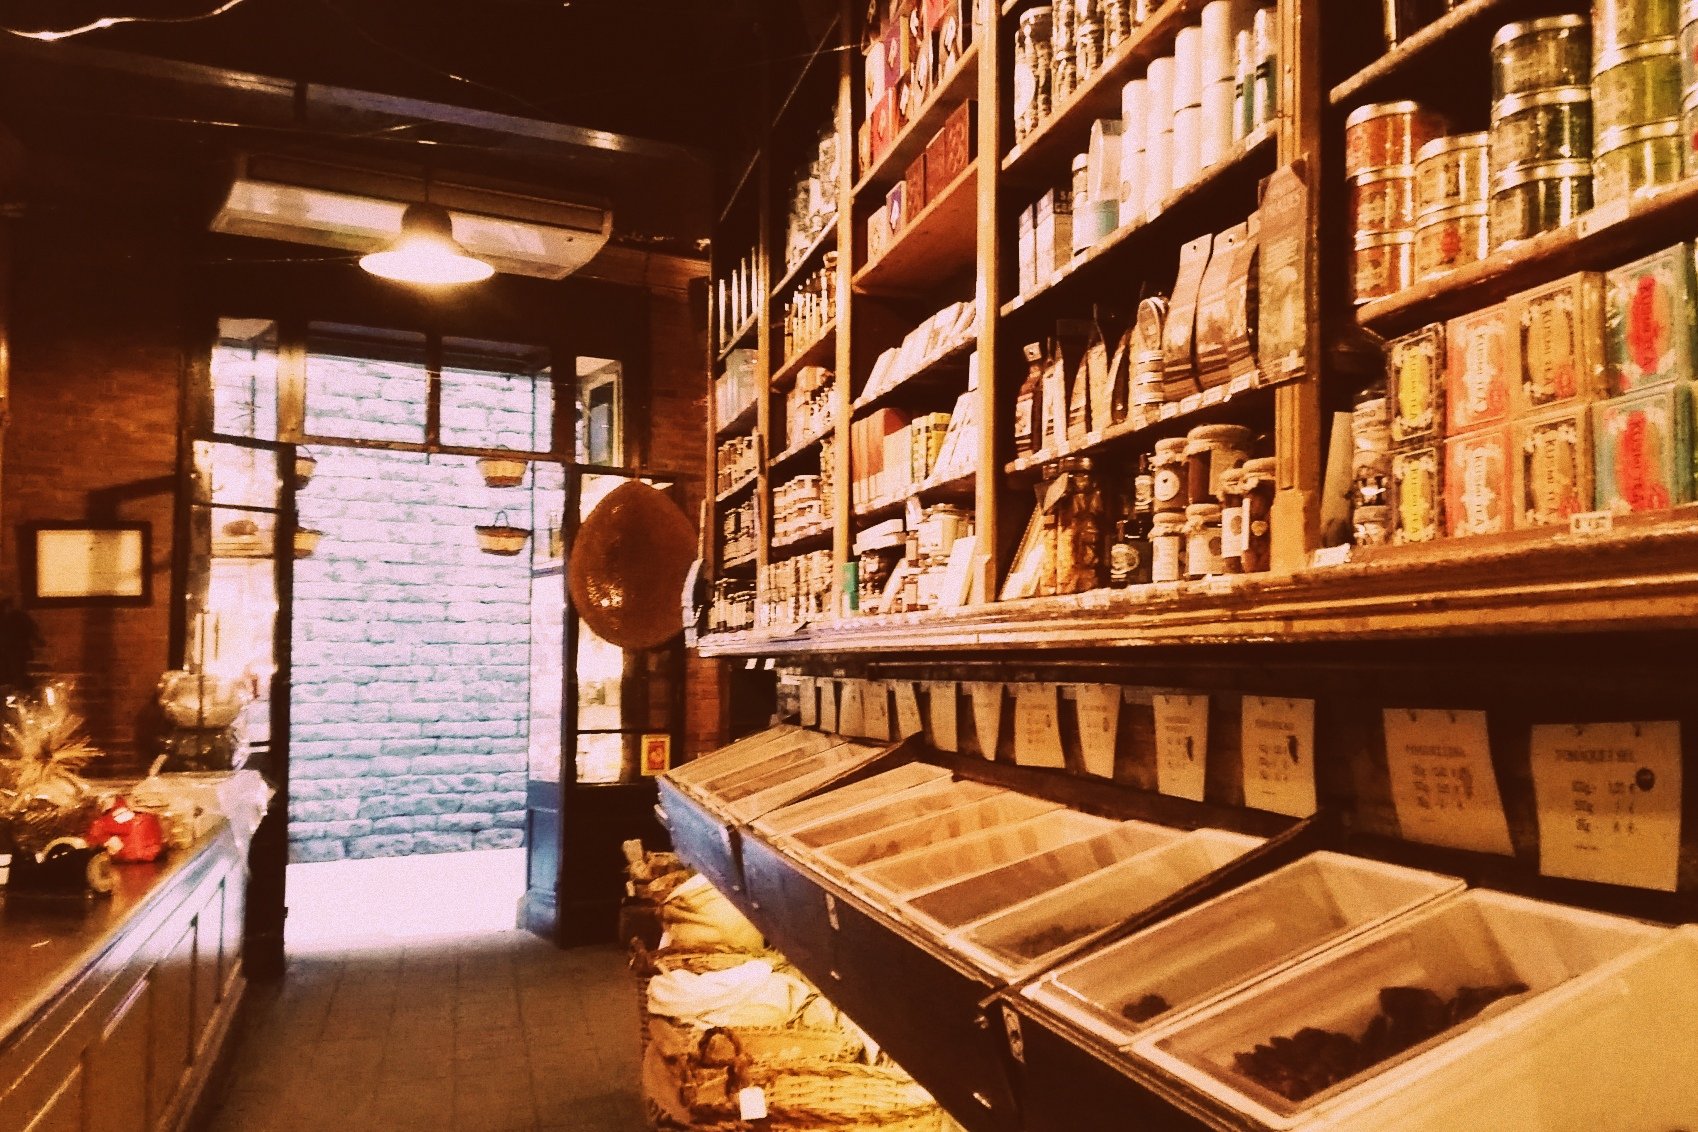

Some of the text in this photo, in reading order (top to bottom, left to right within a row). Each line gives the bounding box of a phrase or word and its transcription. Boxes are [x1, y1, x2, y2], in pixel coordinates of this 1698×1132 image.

[1542, 309, 1553, 386] KUSMI TEA
[1545, 439, 1556, 516] KUSMI TEA
[1632, 475, 1644, 504] TEA
[1475, 503, 1483, 527] TEA
